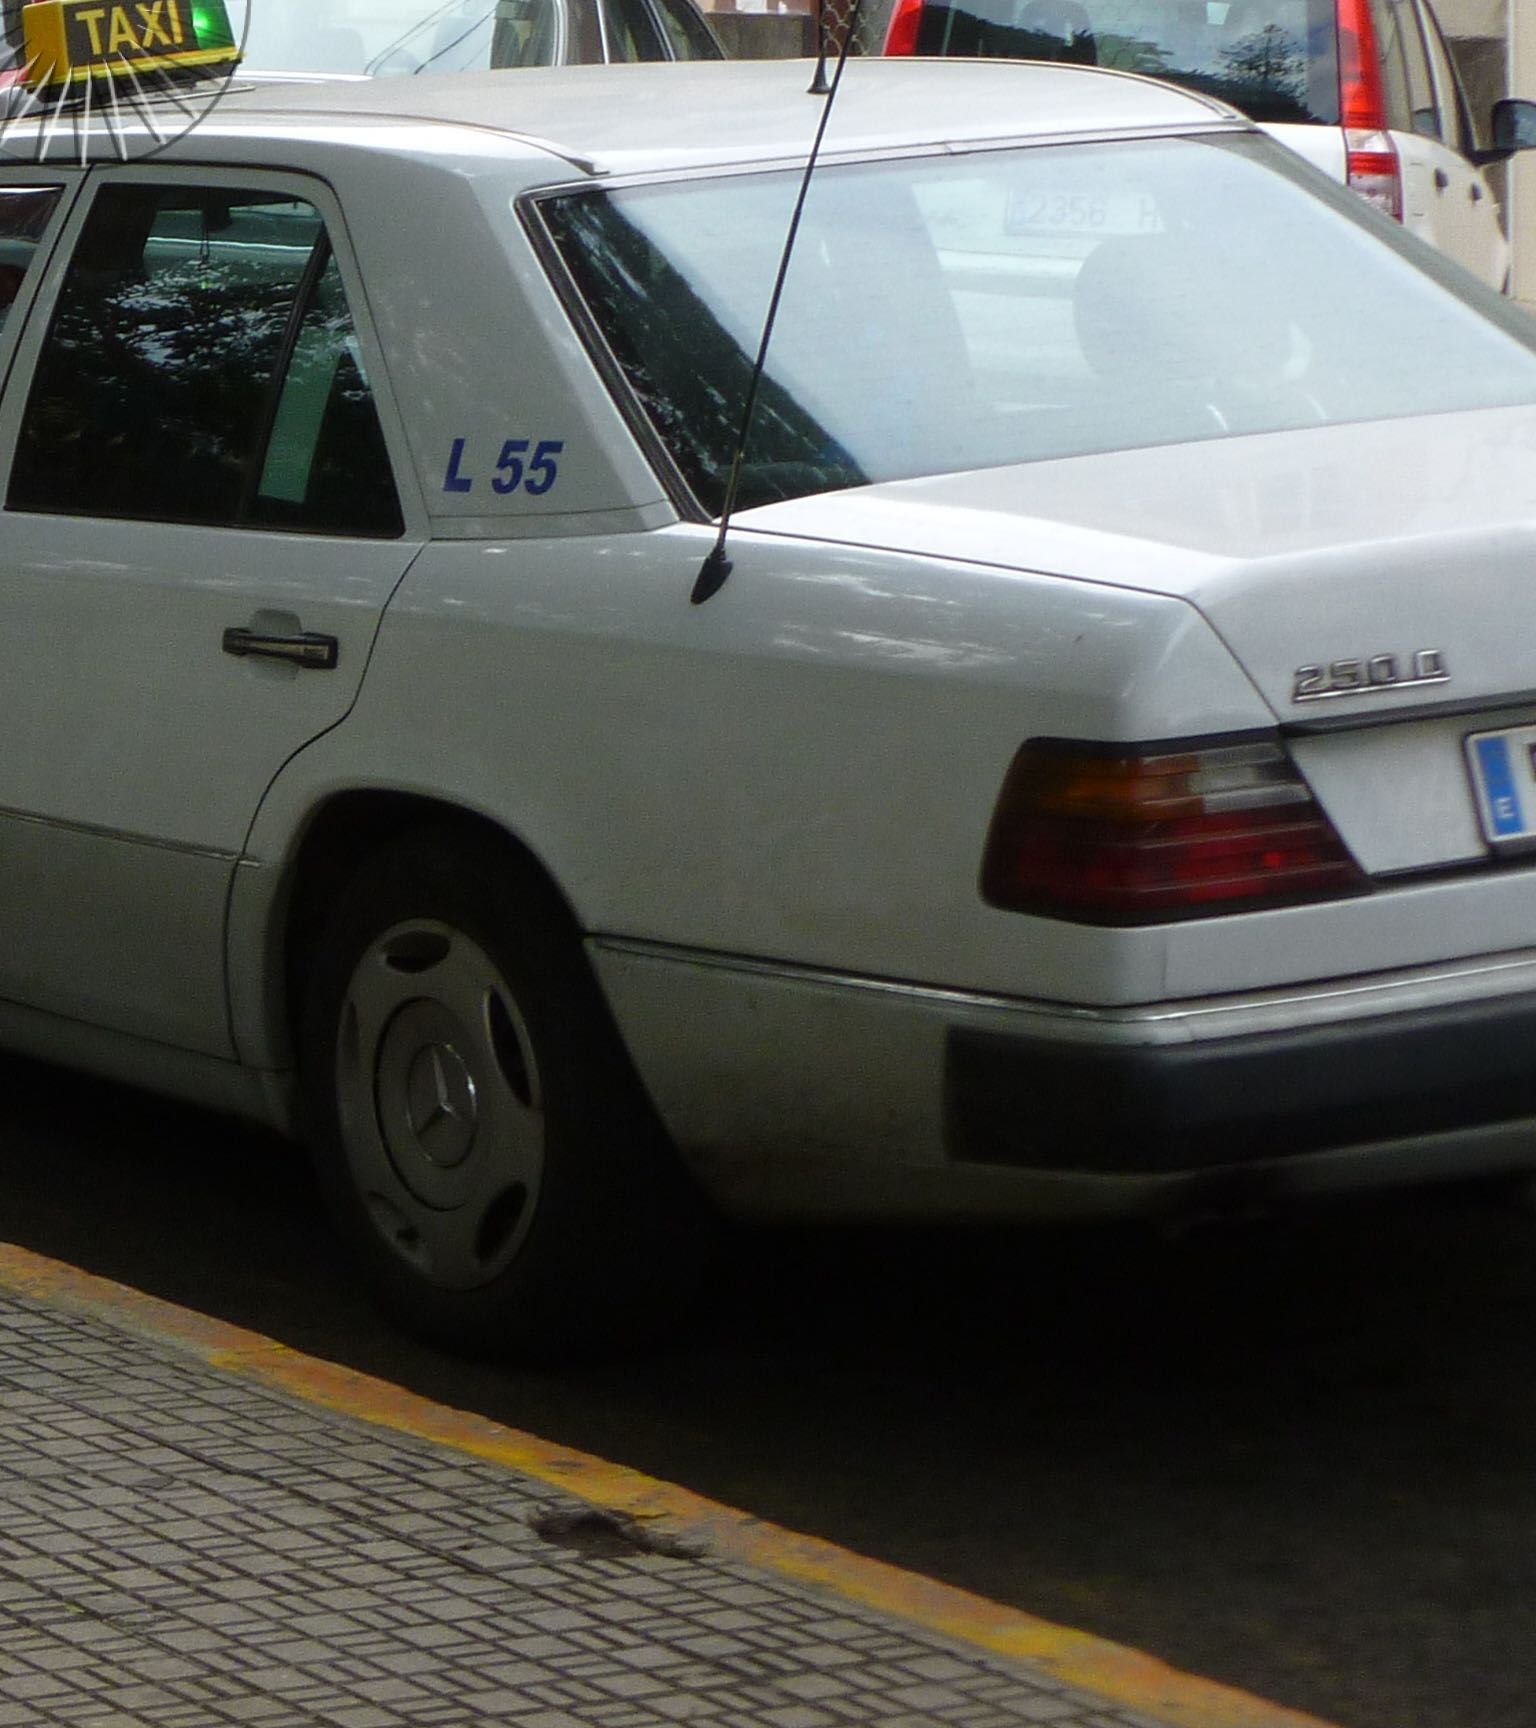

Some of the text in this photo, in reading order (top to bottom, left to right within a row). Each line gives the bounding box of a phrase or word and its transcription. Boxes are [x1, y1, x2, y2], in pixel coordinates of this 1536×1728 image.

[442, 437, 565, 495] L 55
[1293, 651, 1397, 696] 250
[1496, 797, 1516, 819] E
